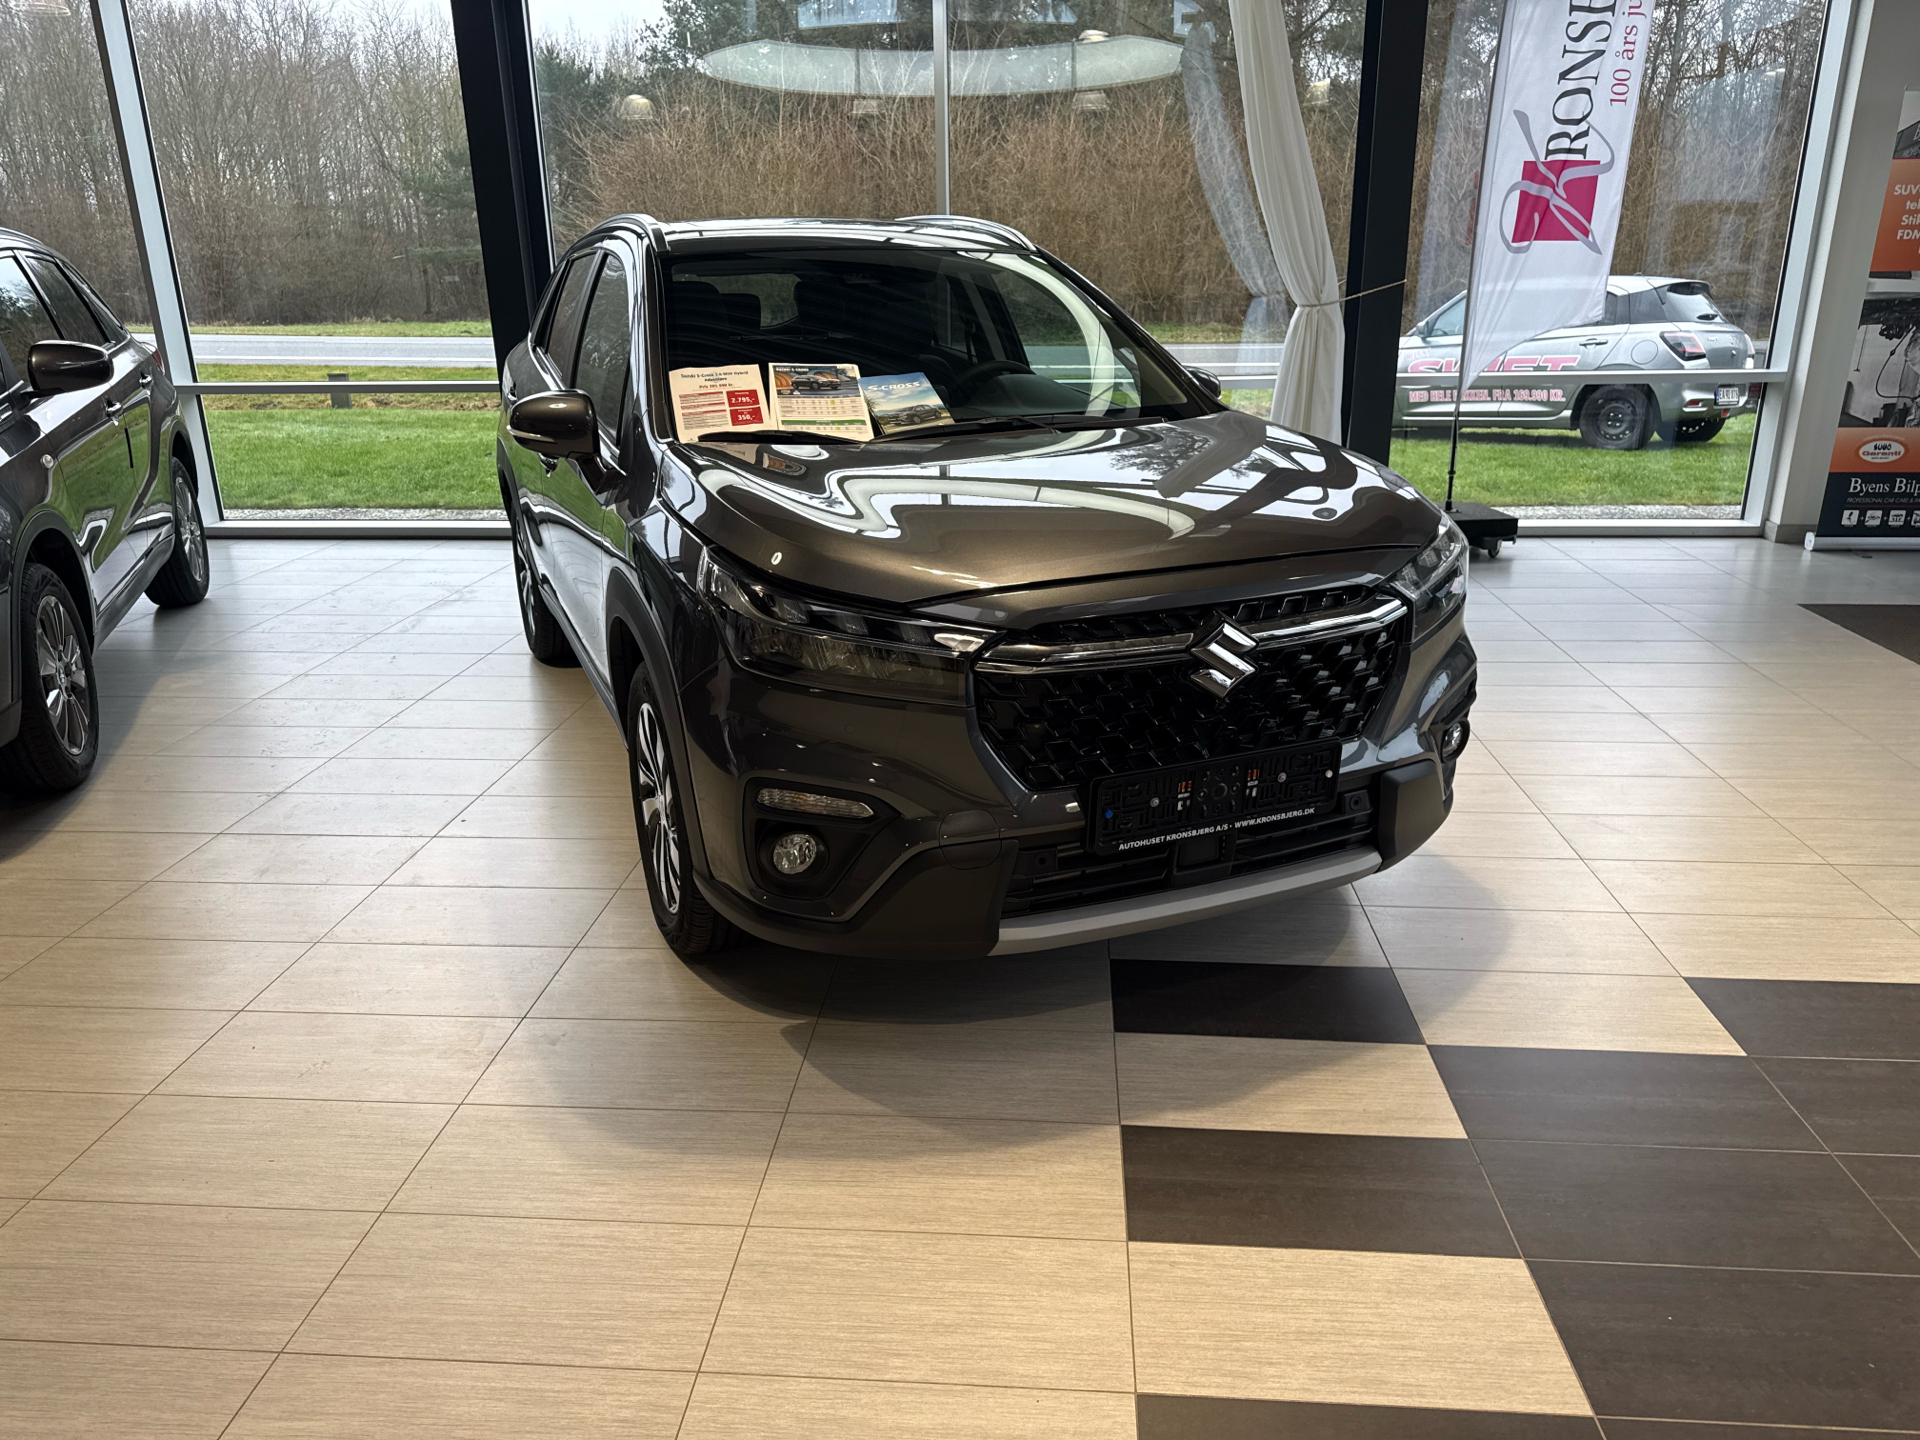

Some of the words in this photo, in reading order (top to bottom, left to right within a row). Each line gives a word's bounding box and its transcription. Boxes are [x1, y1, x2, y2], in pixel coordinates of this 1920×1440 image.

[1615, 24, 1638, 61] års
[1609, 68, 1632, 106] 100
[1893, 184, 1920, 196] SUV
[1408, 355, 1581, 372] SFT
[867, 381, 921, 392] S-CROSS
[1408, 390, 1429, 403] MED
[1430, 390, 1452, 402] HELE
[1452, 389, 1492, 402] PKKEN.
[1492, 389, 1512, 401] FRA
[1549, 389, 1567, 402] KR.
[1848, 477, 1890, 496] Byens
[1118, 834, 1166, 851] AUTOHUSET
[1166, 825, 1215, 842] KRONSBJERG
[1215, 823, 1229, 833] A/S
[1234, 806, 1315, 830] WWW.KRONSBJERG.DK
